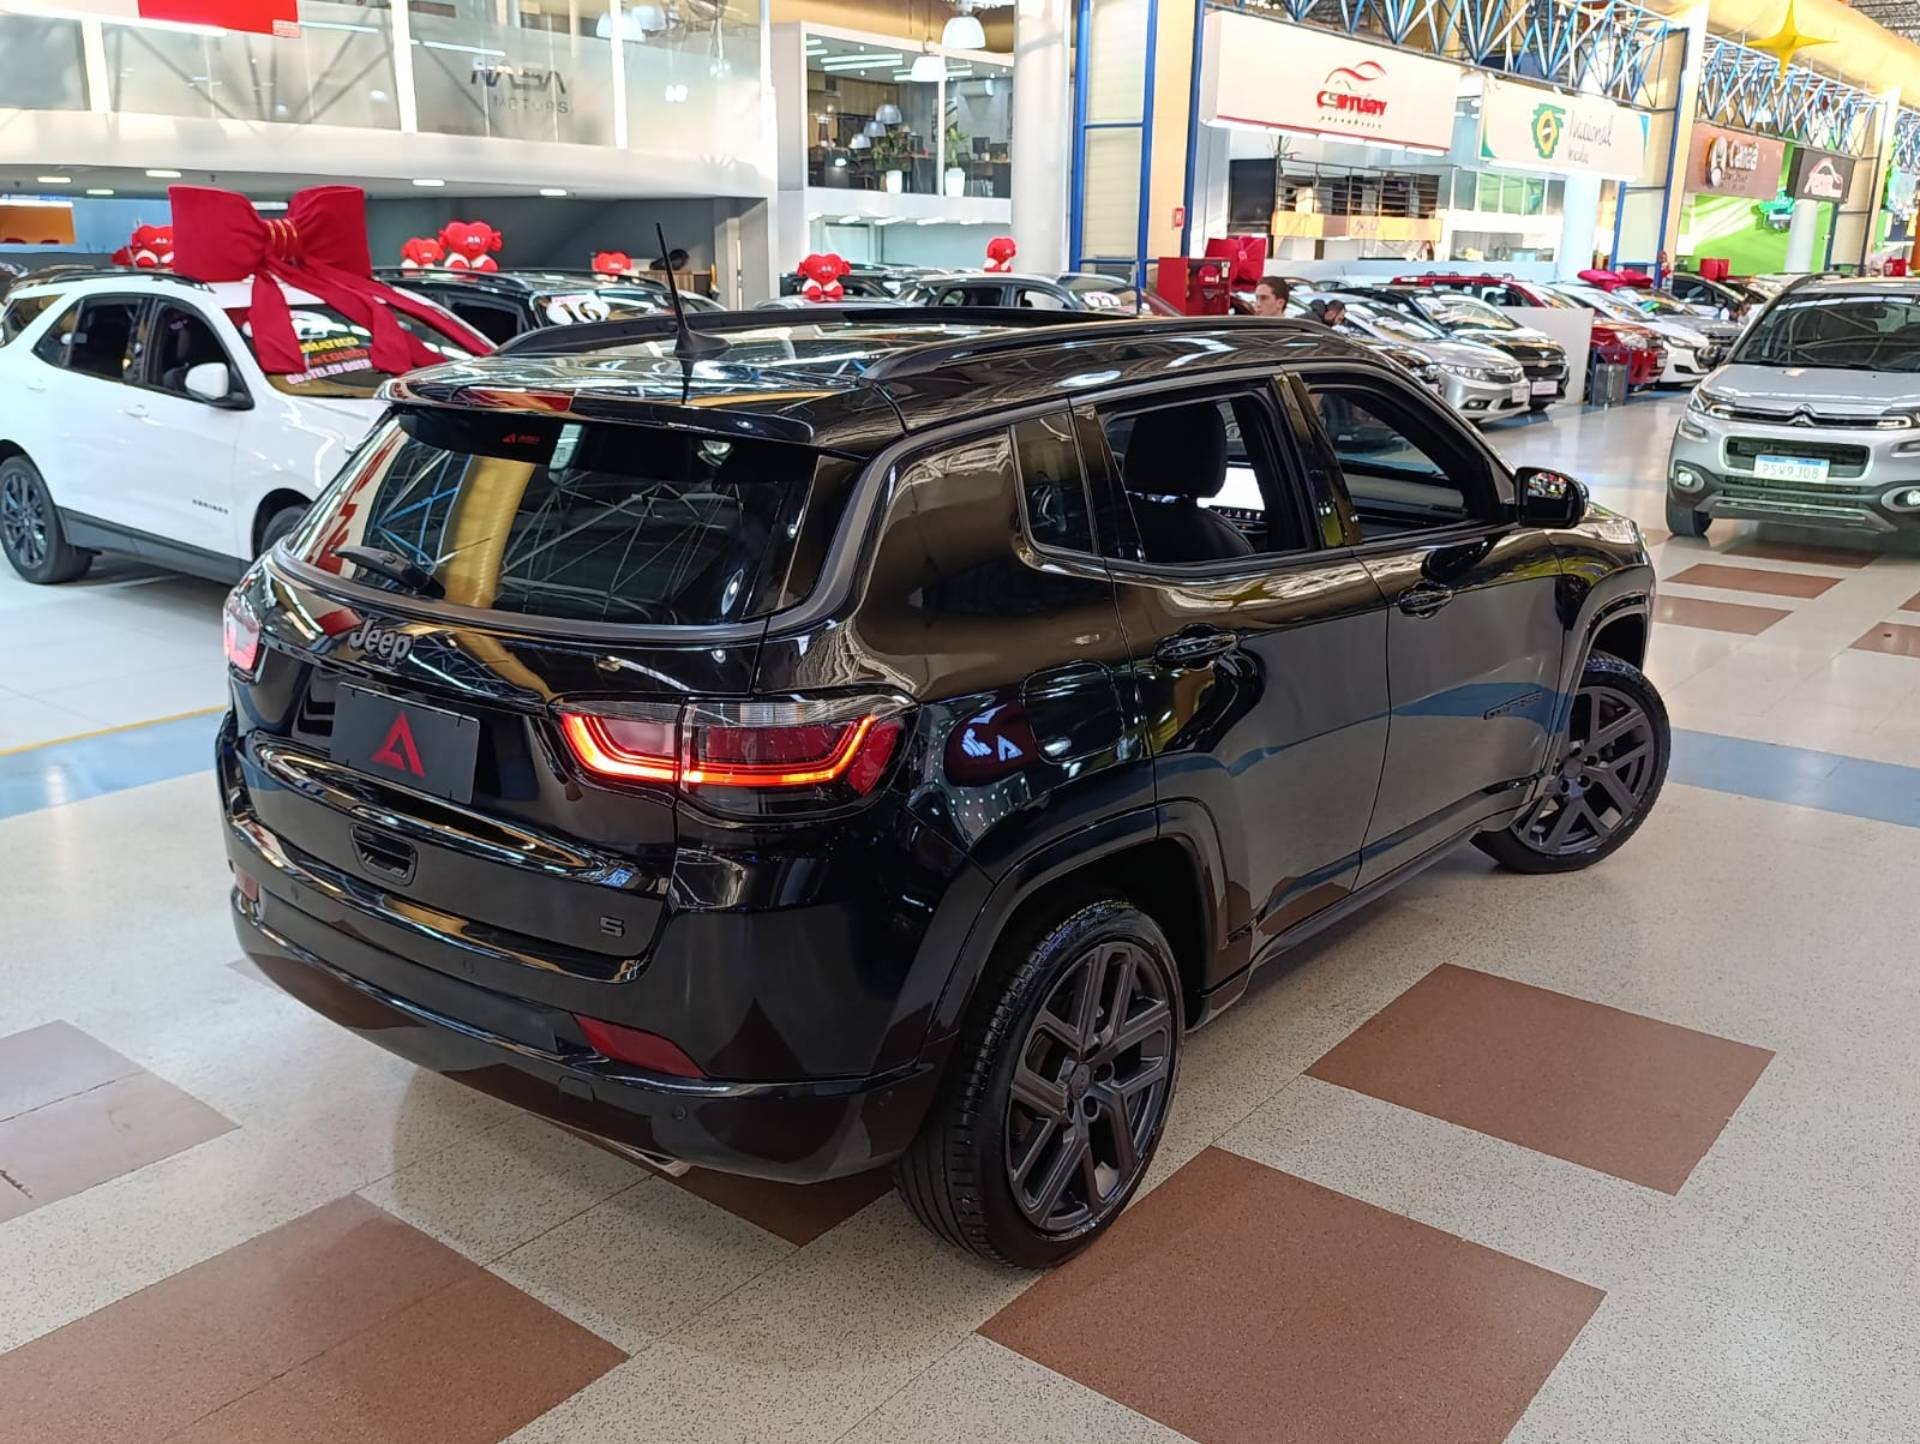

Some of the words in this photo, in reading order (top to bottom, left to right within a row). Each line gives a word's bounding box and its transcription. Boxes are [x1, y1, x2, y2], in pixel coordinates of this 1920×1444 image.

[559, 301, 602, 323] 16
[348, 614, 412, 665] Jeep
[600, 917, 622, 937] S
